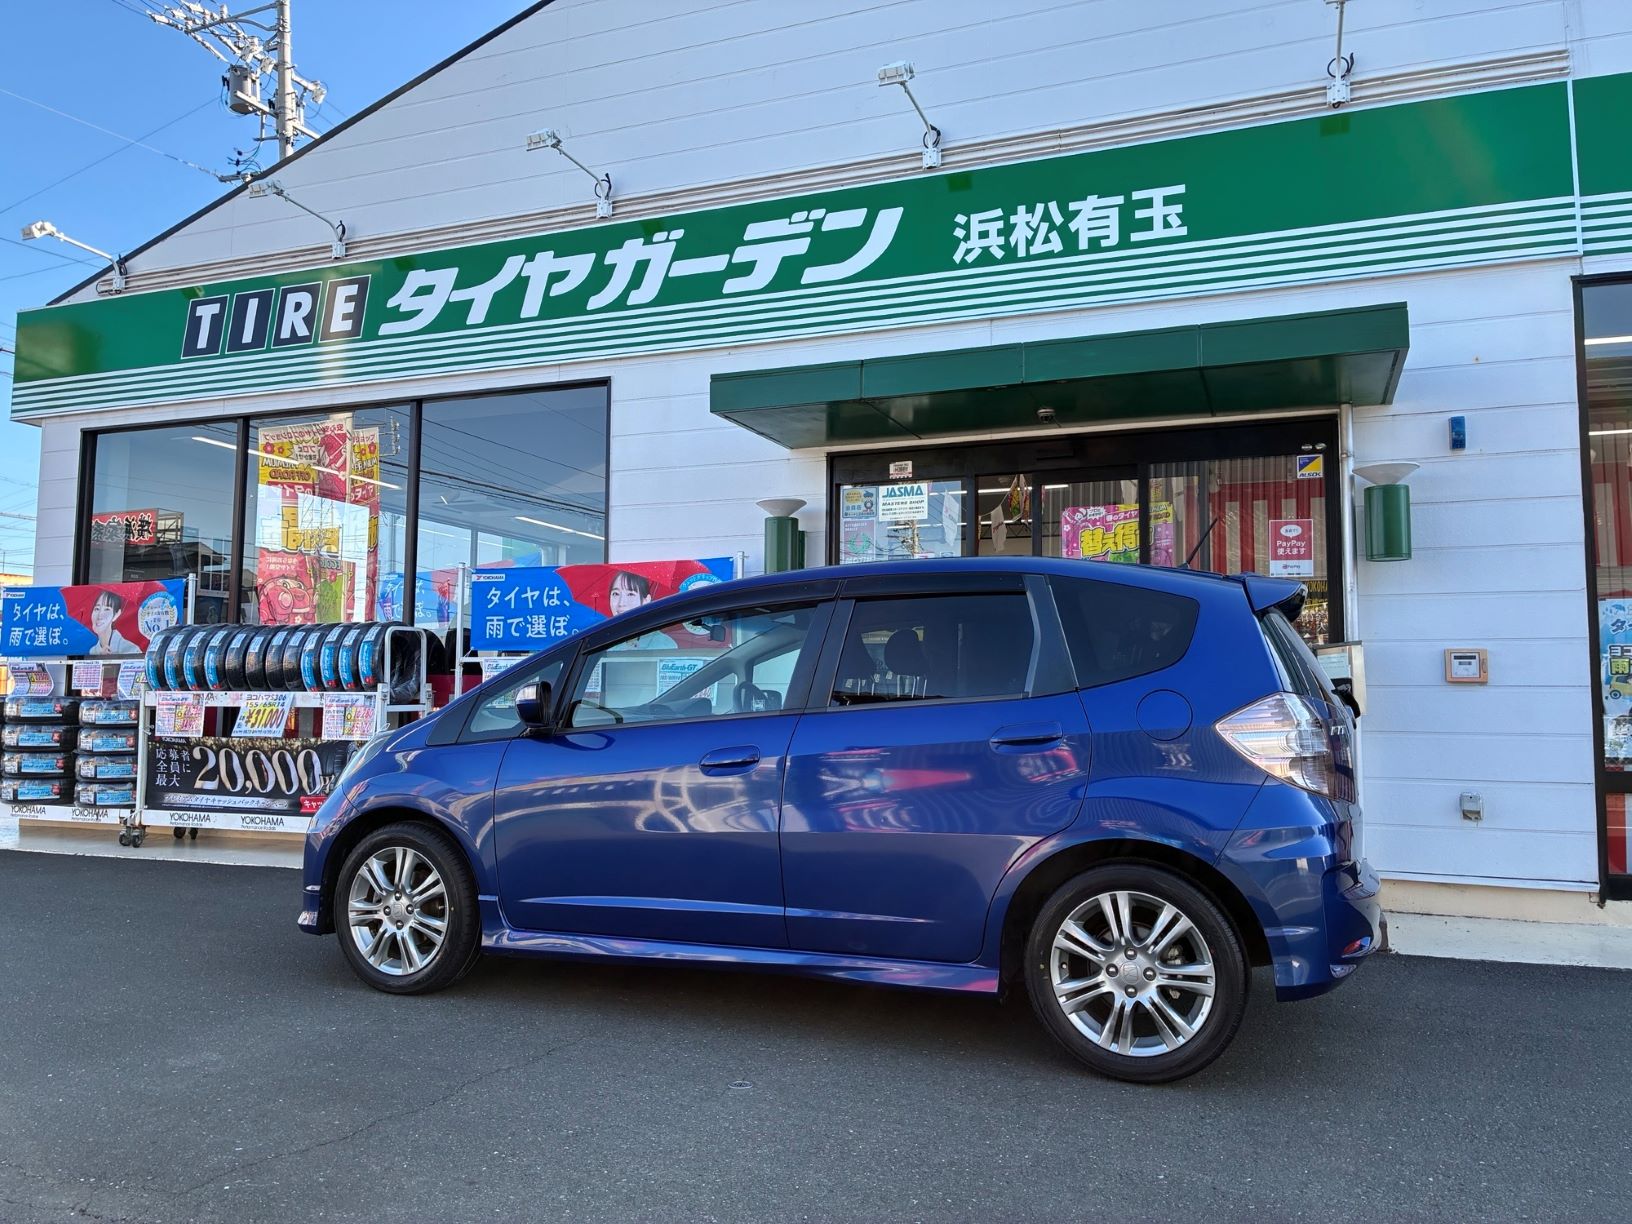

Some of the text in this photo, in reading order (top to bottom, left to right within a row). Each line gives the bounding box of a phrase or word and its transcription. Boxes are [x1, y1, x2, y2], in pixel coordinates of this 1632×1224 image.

[952, 184, 1188, 265] 浜松有玉
[378, 206, 904, 335] タイヤガーデン
[196, 282, 361, 350] TIRE
[882, 485, 923, 498] JASMA
[1277, 547, 1306, 555] 使えます
[487, 586, 570, 609] タイヤは、
[13, 603, 65, 622] タイヤは、
[485, 614, 580, 639] 雨で選ぼ。
[9, 626, 69, 647] 雨で選ぼ。
[155, 748, 191, 762] 応募者
[155, 761, 192, 774] 全員に
[155, 774, 180, 787] 最大
[10, 805, 46, 815] YOKOHAMA
[71, 808, 108, 818] YOKOHAMA
[169, 812, 211, 822] YOKOHAMA
[240, 815, 284, 827] YOKOHAMA
